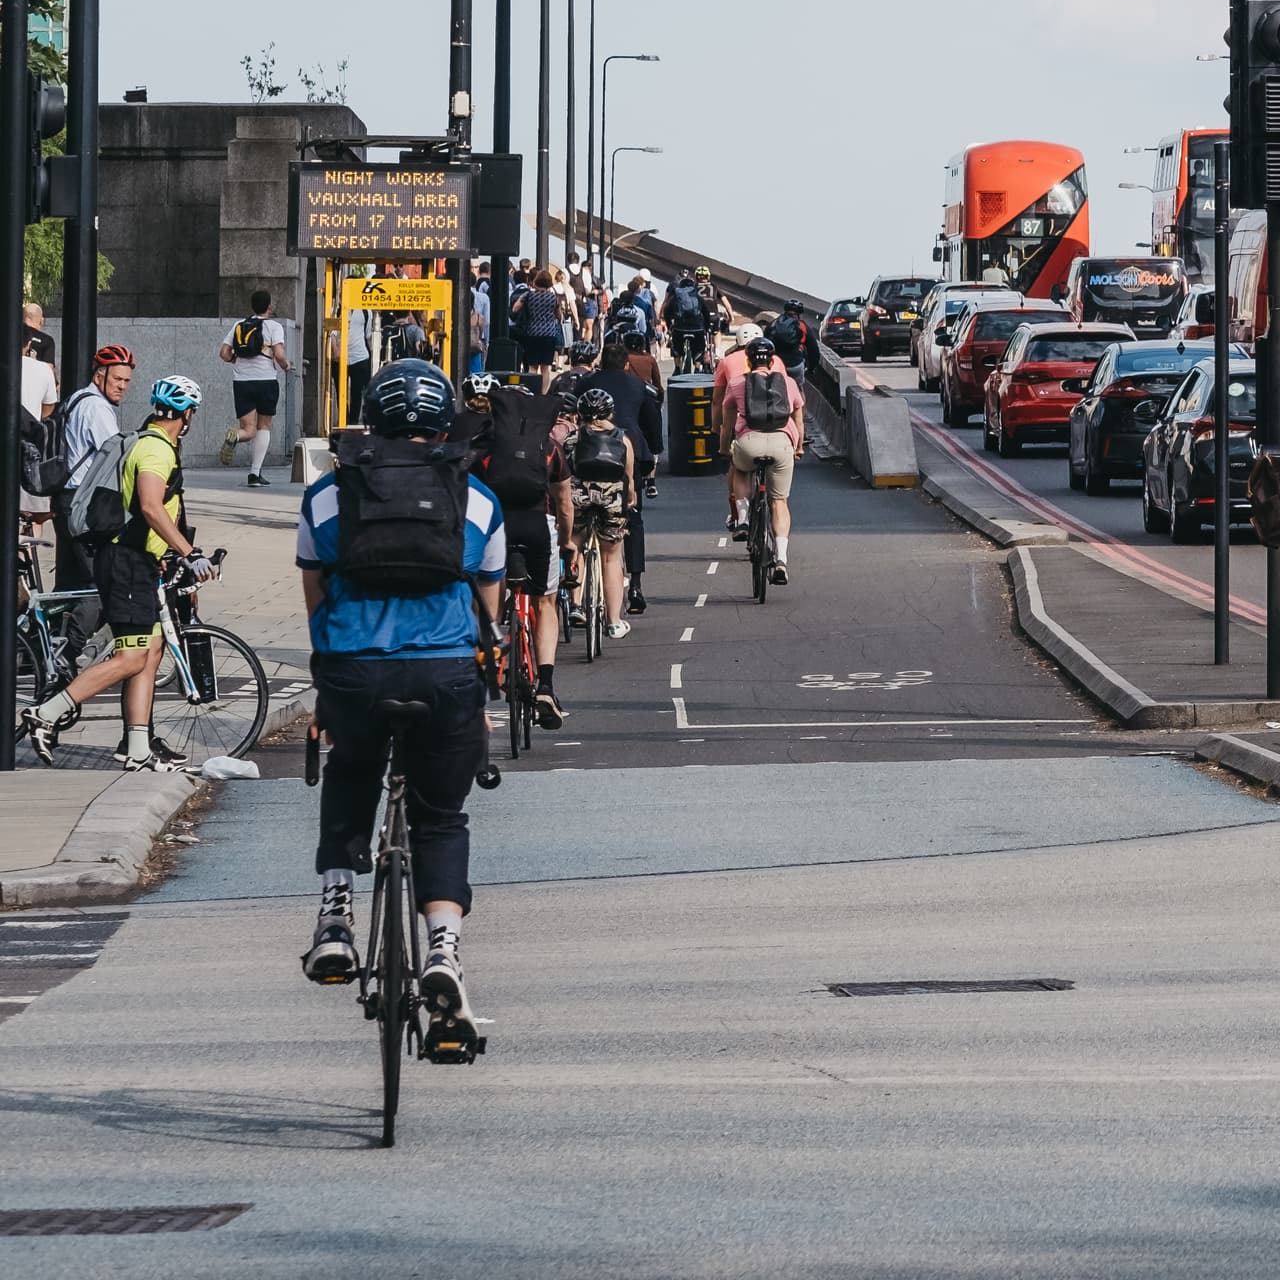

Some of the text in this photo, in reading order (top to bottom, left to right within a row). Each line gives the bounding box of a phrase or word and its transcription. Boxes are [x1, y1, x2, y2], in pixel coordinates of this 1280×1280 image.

[325, 171, 445, 186] NIGHT WORKS
[308, 192, 458, 208] VAUXHALL AREA
[309, 213, 458, 228] FROM 17 MARCH
[1023, 220, 1041, 234] 87
[313, 235, 458, 250] EXPECT DELAYS
[1090, 271, 1175, 287] MOLSON Coors
